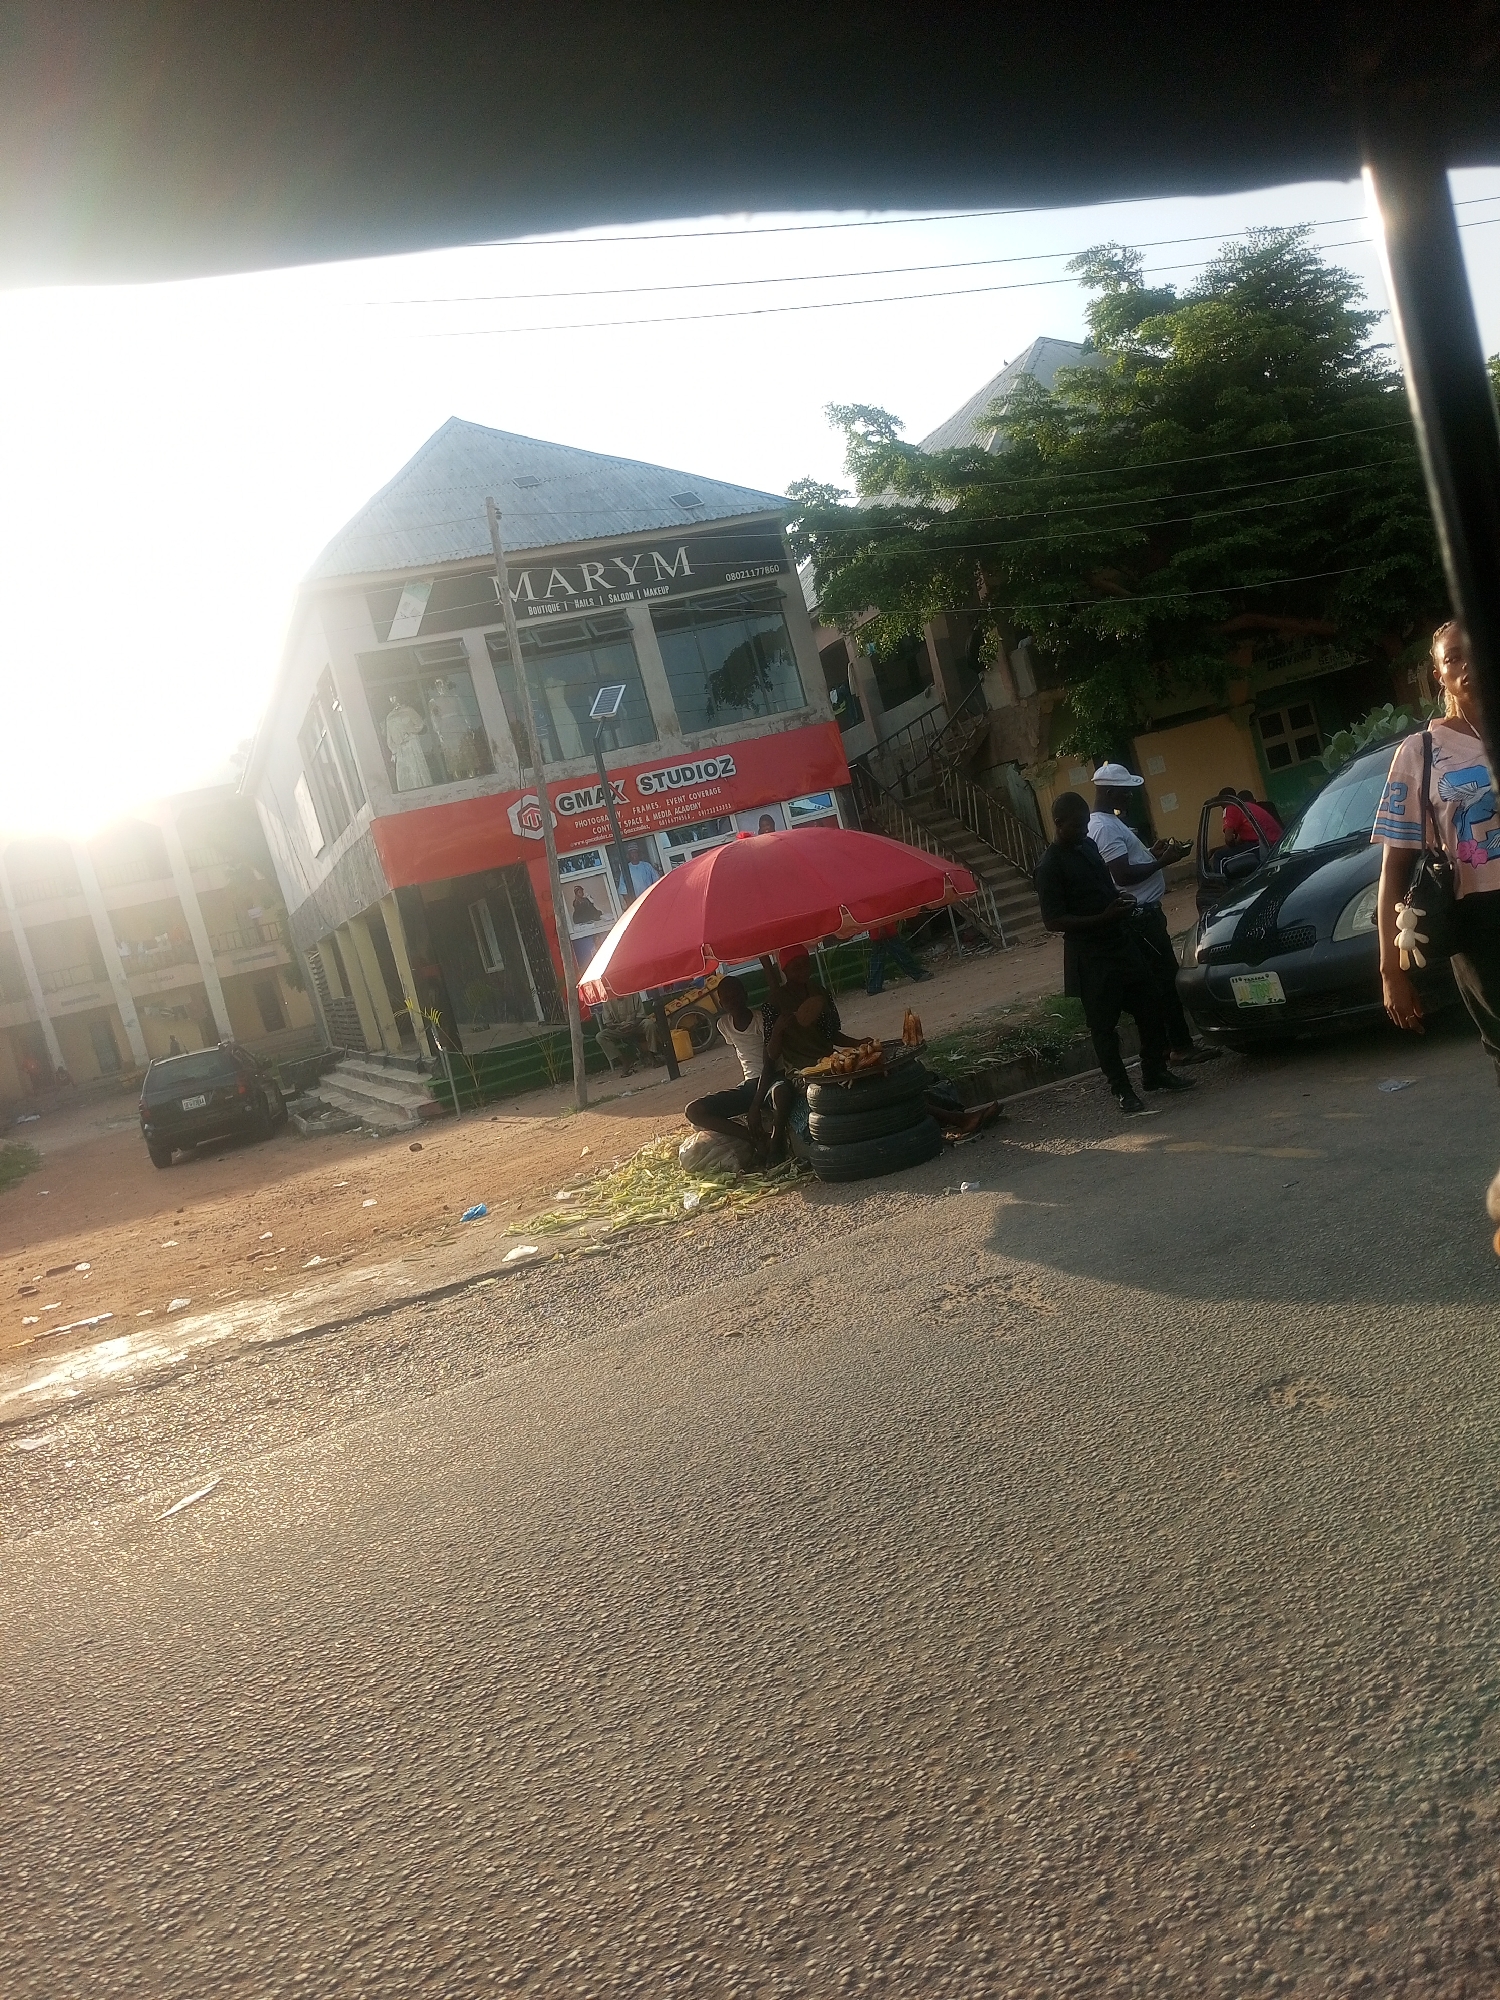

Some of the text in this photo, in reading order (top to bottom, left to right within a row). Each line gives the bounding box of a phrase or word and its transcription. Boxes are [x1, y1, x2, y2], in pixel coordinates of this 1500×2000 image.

[487, 545, 695, 605] MARYM
[528, 602, 560, 616] BOUTIQUE
[643, 585, 669, 598] MAKEUP
[556, 754, 737, 815] GMAX STUDIOZ
[666, 795, 686, 806] EVENT
[689, 786, 721, 800] COVERAGE
[624, 816, 643, 828] SPACE
[653, 809, 672, 820] MEDIA
[674, 802, 701, 816] ACADEMY
